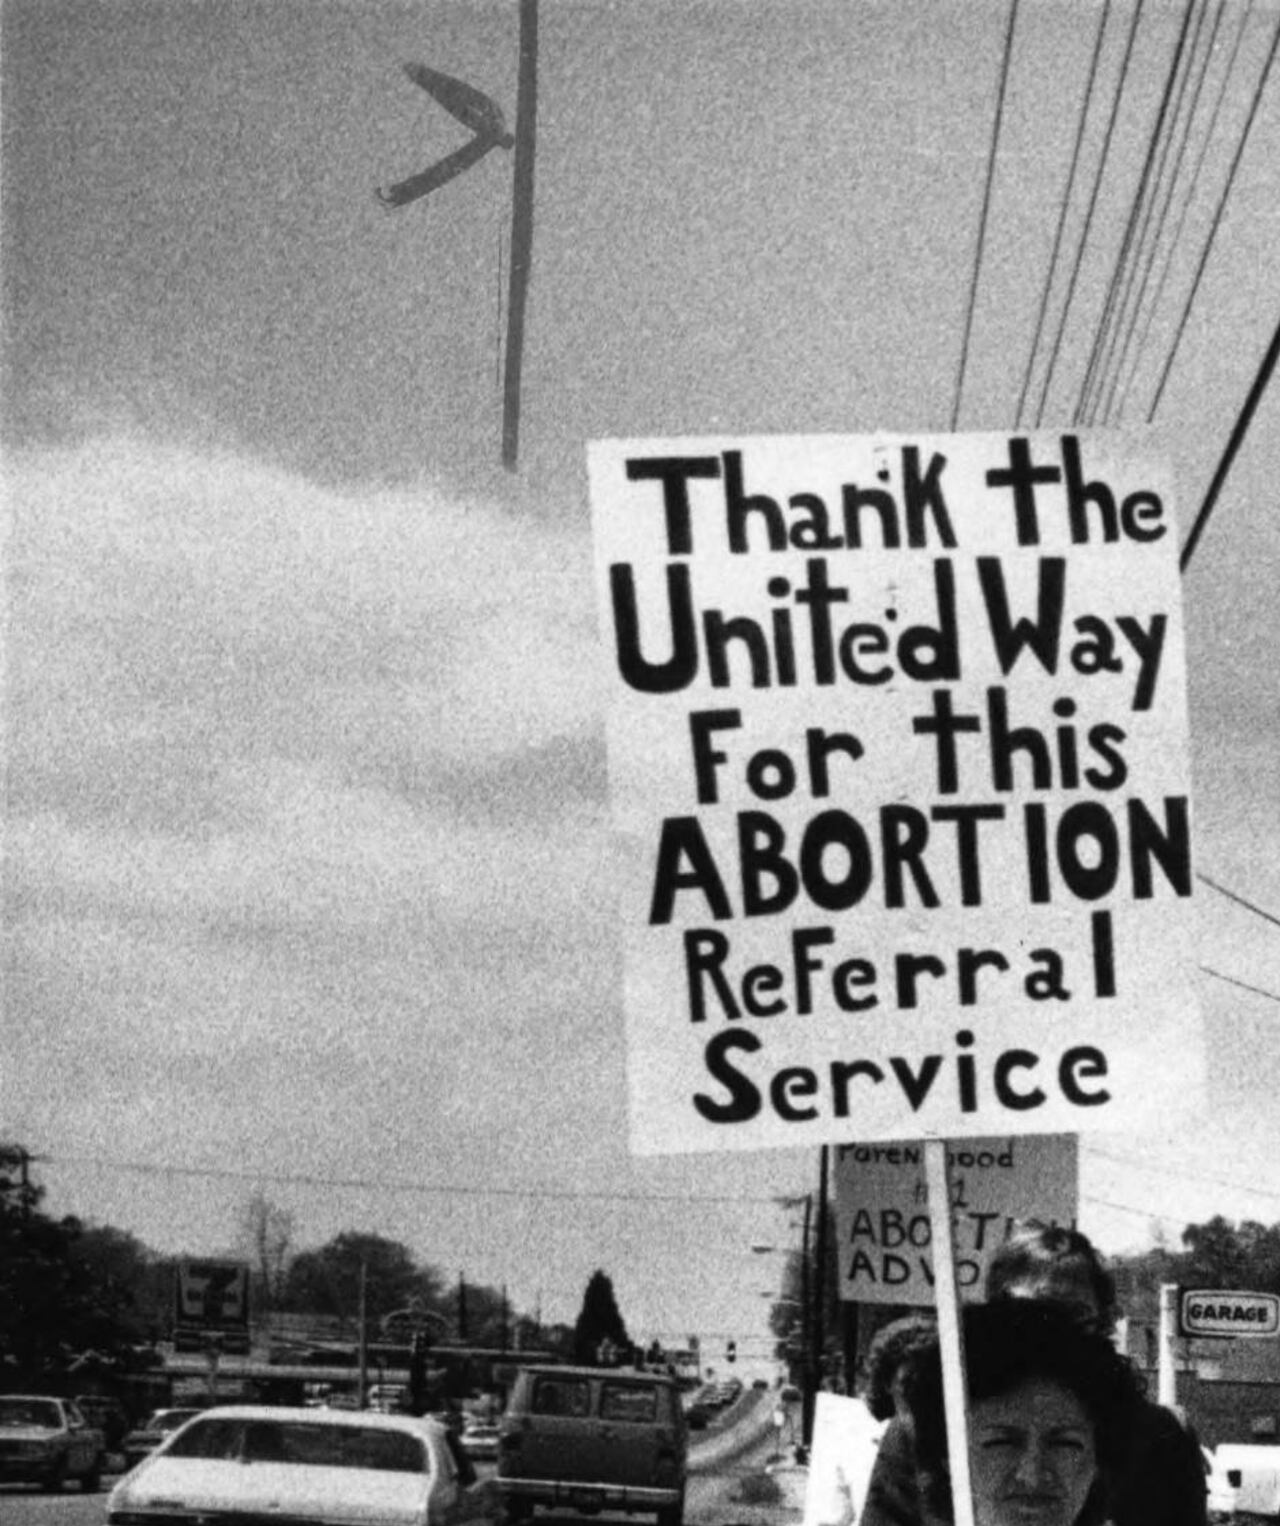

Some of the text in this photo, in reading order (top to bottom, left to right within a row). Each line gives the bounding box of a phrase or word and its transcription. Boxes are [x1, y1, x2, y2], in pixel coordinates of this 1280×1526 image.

[985, 435, 1168, 546] the
[610, 557, 1168, 711] United Way
[689, 686, 1128, 804] For this
[649, 796, 1193, 924] ABORTION
[692, 1029, 1111, 1124] Service
[1191, 1303, 1267, 1323] GARAGE
